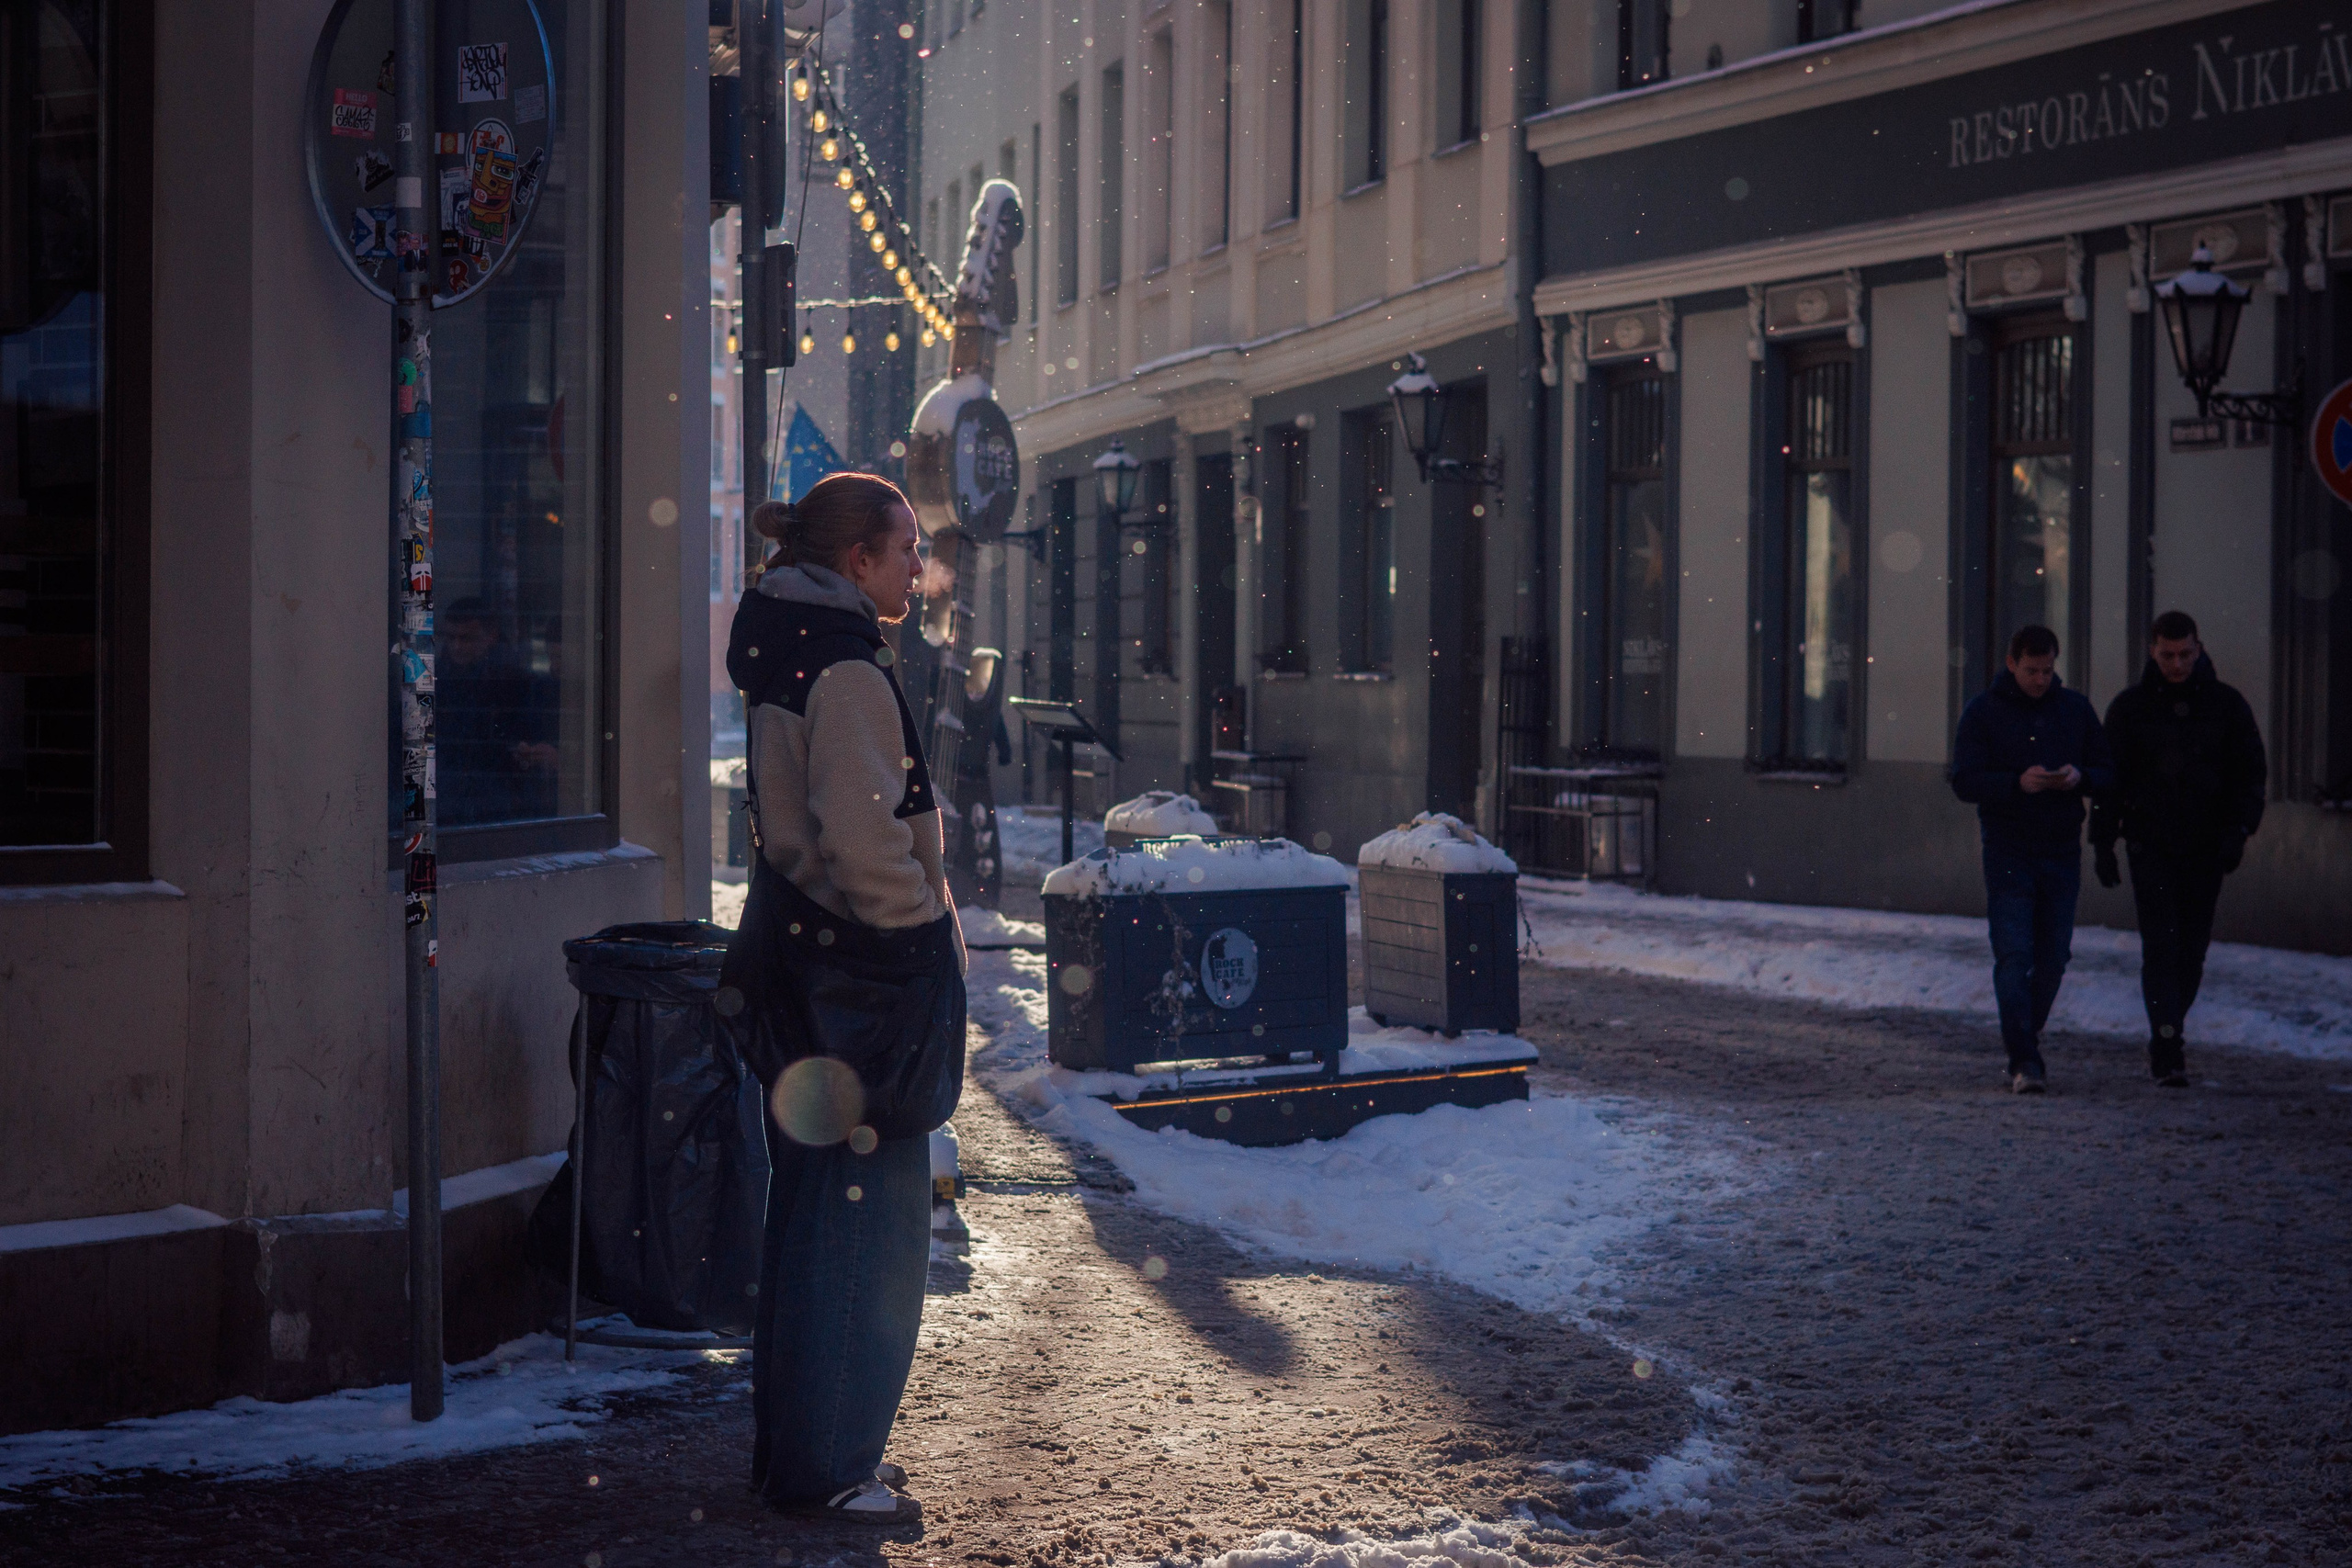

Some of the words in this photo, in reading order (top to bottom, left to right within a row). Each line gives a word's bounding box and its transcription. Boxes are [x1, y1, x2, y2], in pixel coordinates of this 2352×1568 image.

[345, 93, 368, 103] HELLO
[1948, 72, 2171, 168] RESTORĀNS
[1215, 958, 1244, 969] ROCK
[1216, 968, 1245, 978] CAFE
